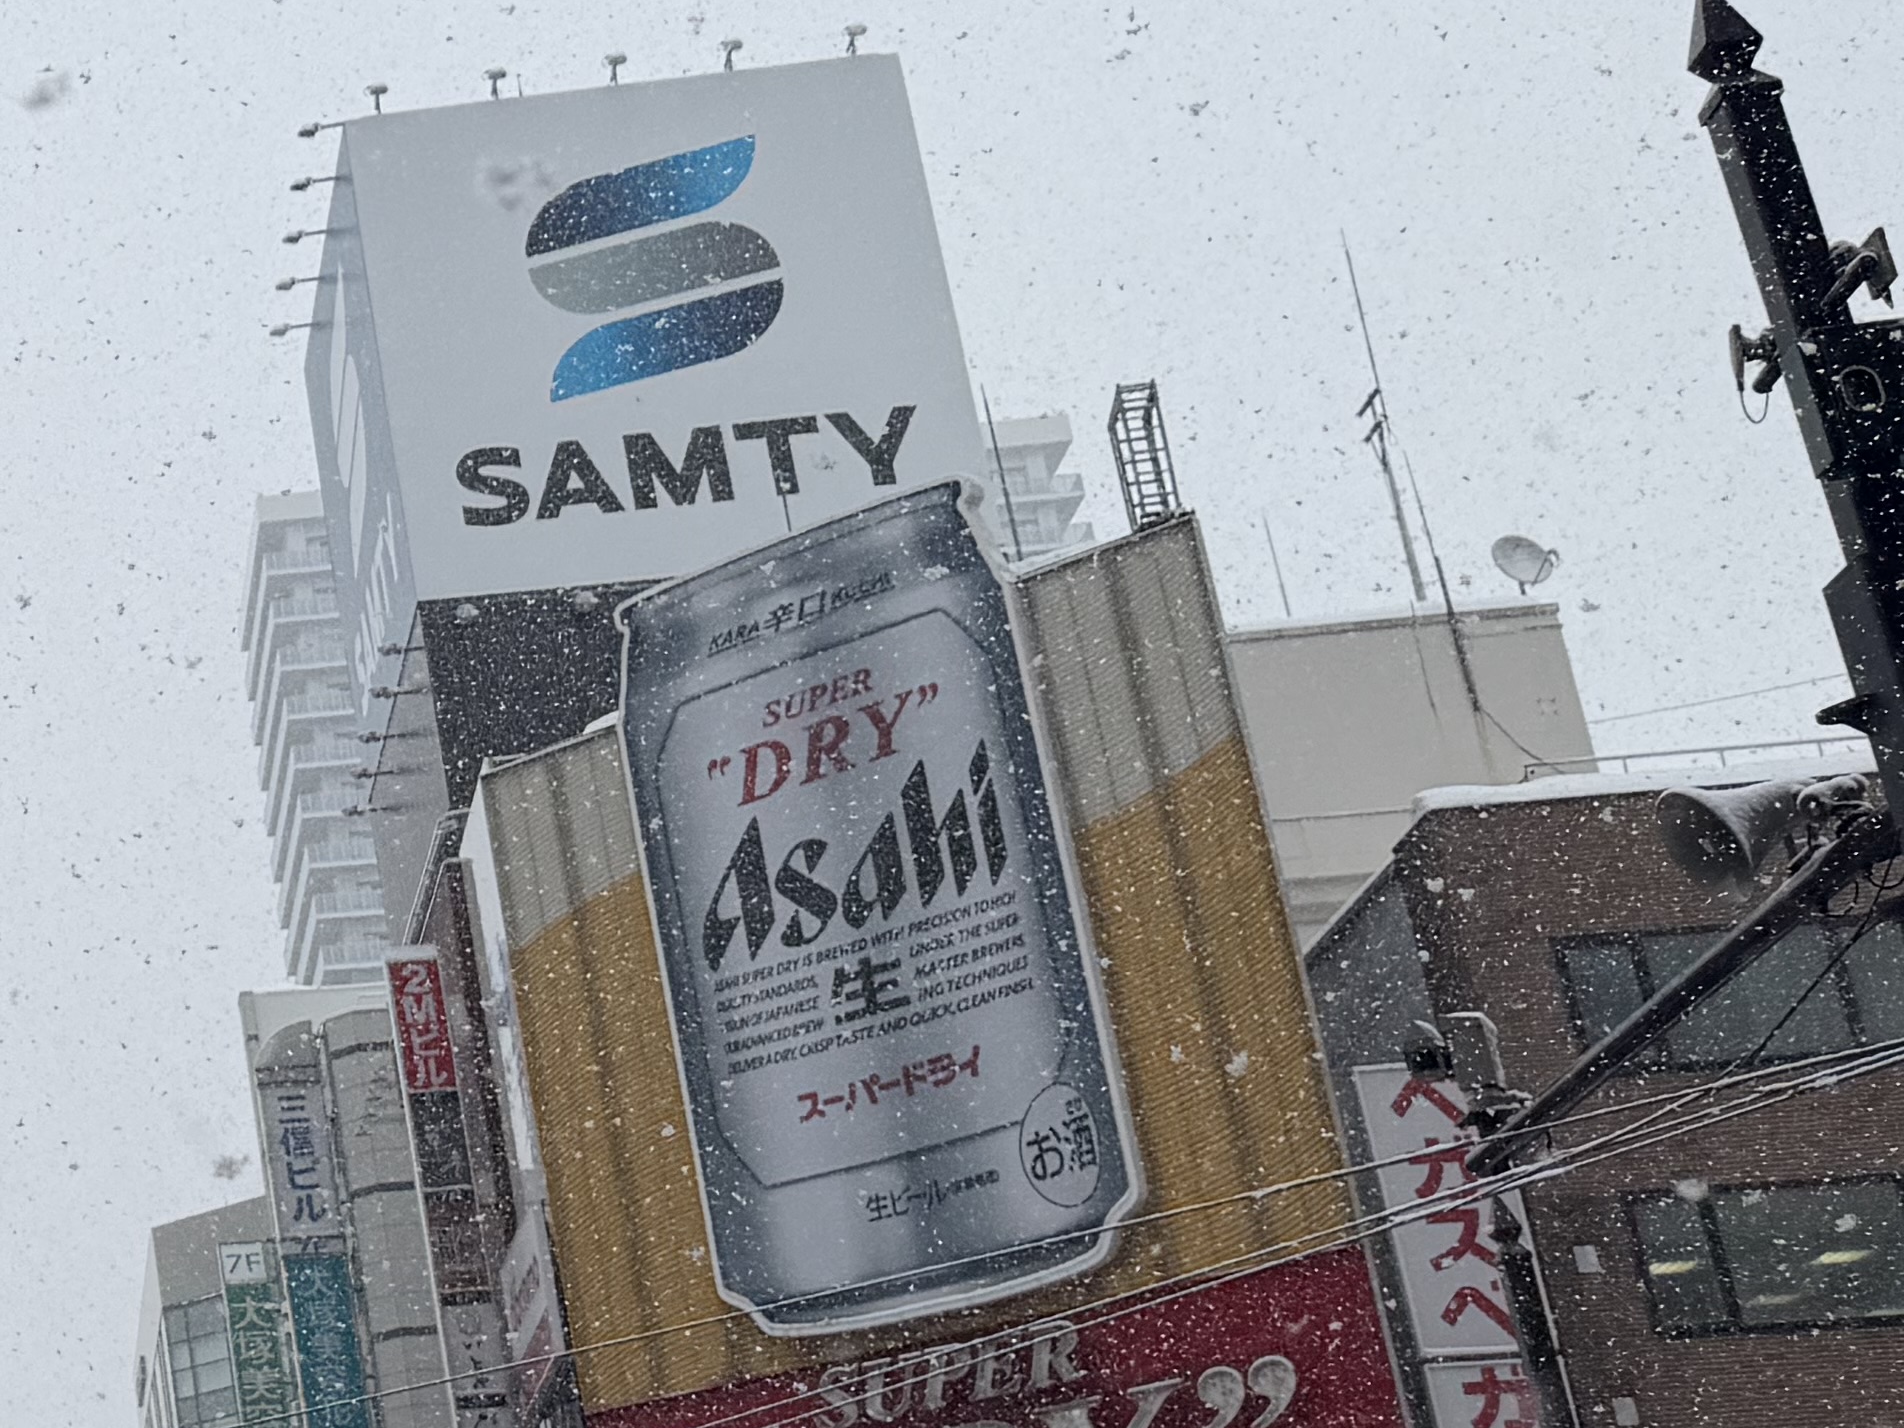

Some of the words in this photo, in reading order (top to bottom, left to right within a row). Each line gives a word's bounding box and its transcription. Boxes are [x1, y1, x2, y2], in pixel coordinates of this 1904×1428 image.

[455, 404, 917, 527] SAMTY
[763, 668, 874, 728] SUPER
[703, 738, 1008, 972] Asahi
[398, 962, 450, 1086] 2Mビル
[796, 1044, 981, 1124] スーパードライ
